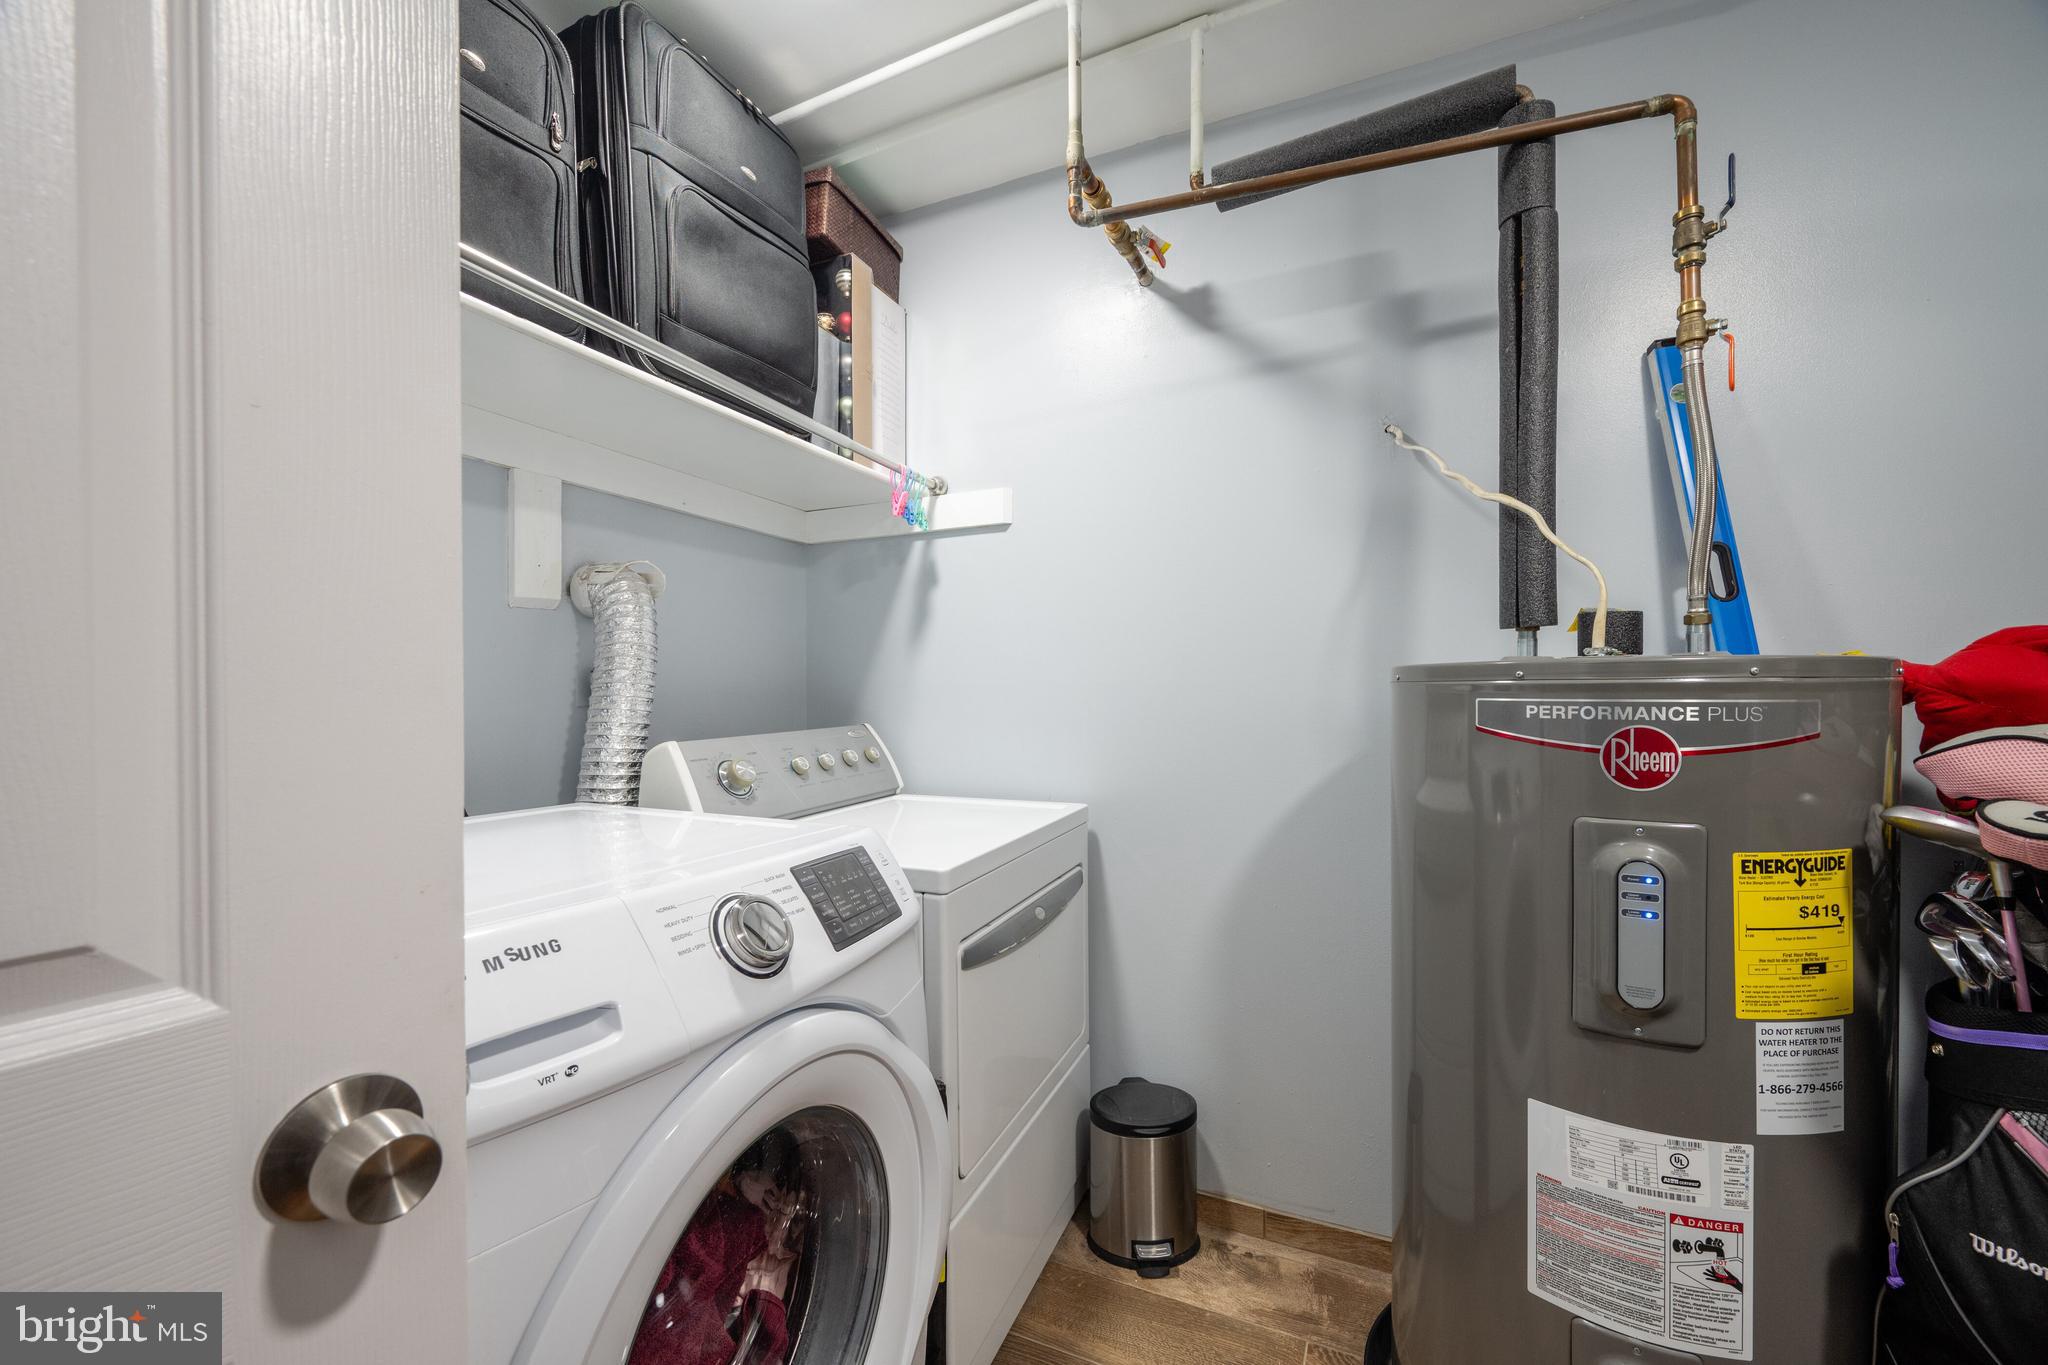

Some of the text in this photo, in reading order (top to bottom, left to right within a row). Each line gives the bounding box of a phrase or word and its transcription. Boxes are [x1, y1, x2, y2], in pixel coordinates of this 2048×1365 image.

[1525, 706, 1699, 721] PERFORMANCE
[1611, 728, 1675, 779] Rheem
[1741, 856, 1845, 874] ENERGYGUIDE
[656, 905, 677, 913] NORMAL
[1800, 904, 1840, 920] $419
[671, 931, 693, 942] BEDDING
[482, 939, 562, 974] MSUNG
[1795, 1027, 1824, 1035] RETURN
[1826, 1025, 1840, 1033] THIS
[1789, 1038, 1817, 1046] HEATER
[1802, 1047, 1839, 1056] PURCHASE
[1759, 1081, 1843, 1094] 1-866-279-4566
[1674, 1156, 1685, 1166] UL
[1638, 1206, 1665, 1215] CAUTION
[1688, 1219, 1739, 1231] DANGER
